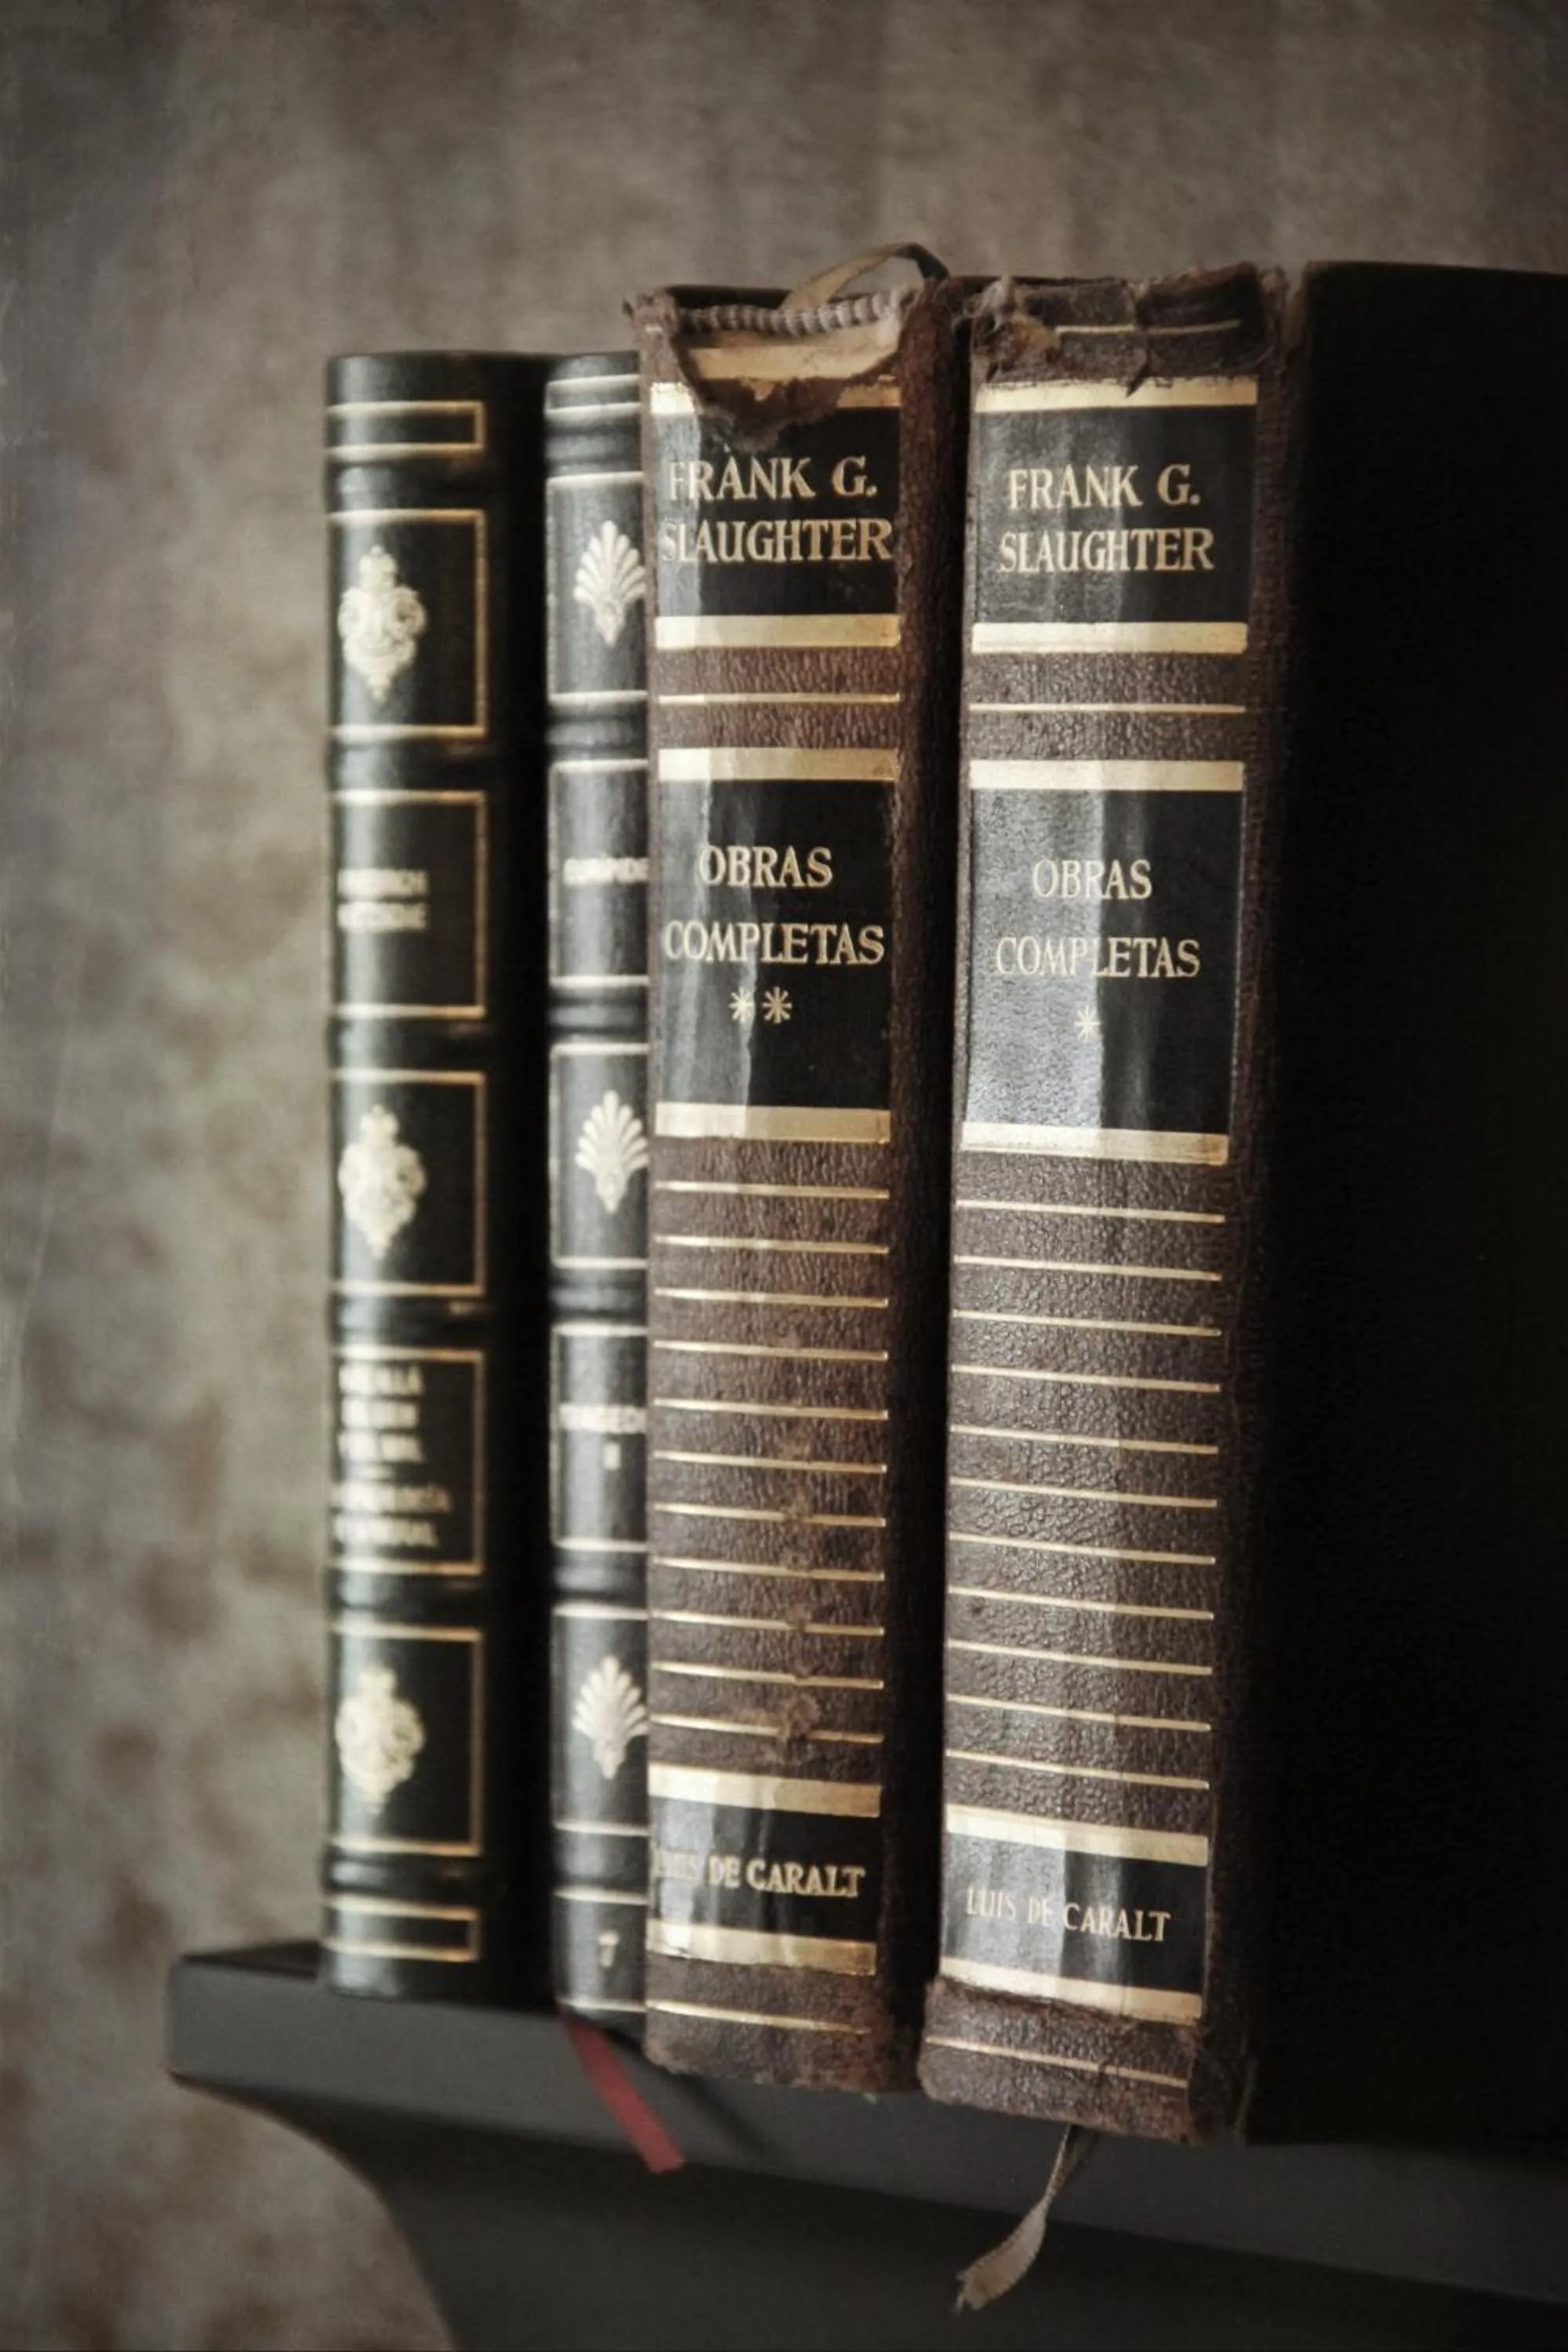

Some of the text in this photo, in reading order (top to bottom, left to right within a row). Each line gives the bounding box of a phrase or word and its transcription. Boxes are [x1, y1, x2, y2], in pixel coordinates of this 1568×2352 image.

[667, 456, 877, 503] FRANK G.
[1008, 463, 1201, 510] FRANK G.
[660, 517, 894, 564] SLAUGHTER
[998, 527, 1214, 574] SLAUGHTER
[699, 844, 833, 888] OBRAS
[1031, 858, 1153, 901] OBRAS
[662, 920, 886, 966] COMPLETAS
[995, 935, 1201, 979] COMPLETAS
[708, 1857, 741, 1888] DE
[746, 1857, 866, 1900] CARALT
[966, 1886, 1017, 1921] LUIS
[1062, 1901, 1172, 1943] CARALT
